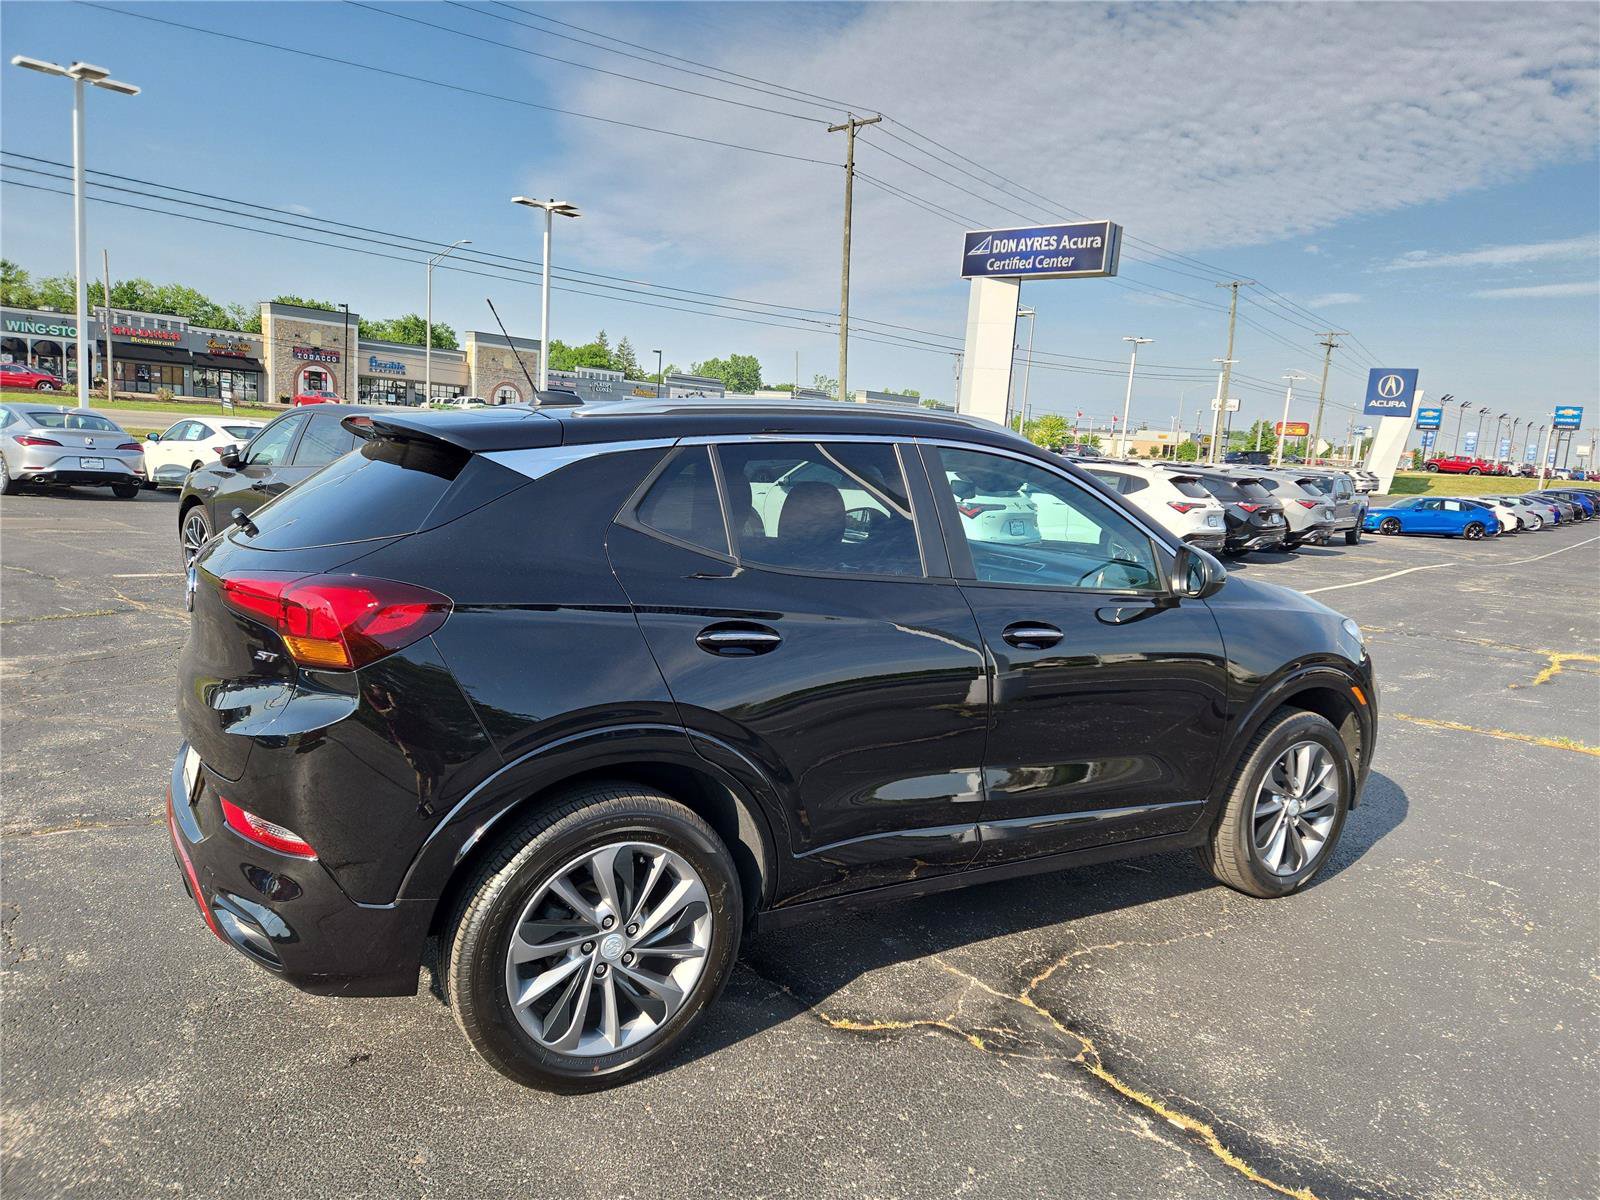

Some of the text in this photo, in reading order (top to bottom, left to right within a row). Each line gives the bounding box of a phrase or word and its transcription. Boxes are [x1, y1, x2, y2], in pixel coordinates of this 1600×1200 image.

[992, 234, 1102, 254] DON AYRES Acura
[986, 255, 1075, 271] Certified Center
[130, 336, 176, 347] Restaurant
[296, 352, 337, 363] TOBACCO
[1368, 400, 1407, 408] ACURA
[253, 650, 278, 663] ST
